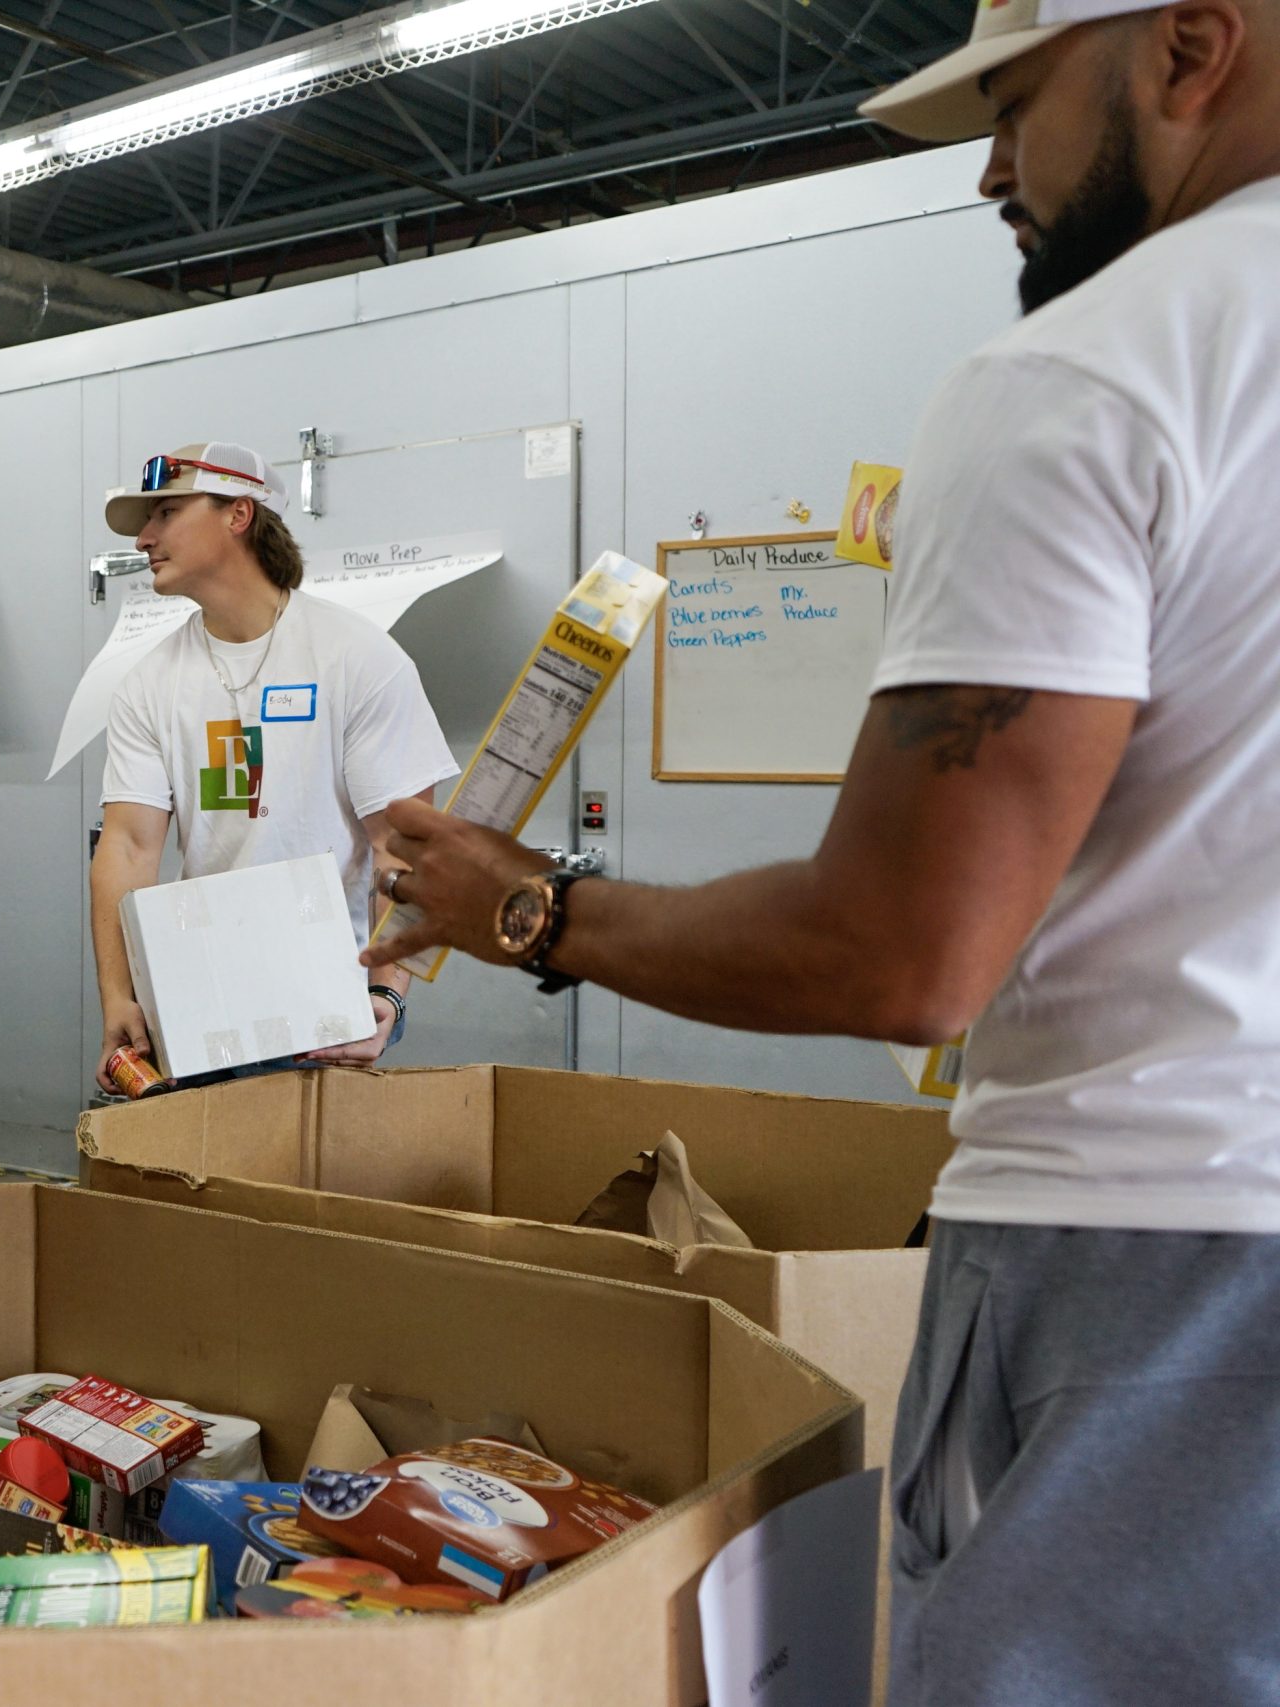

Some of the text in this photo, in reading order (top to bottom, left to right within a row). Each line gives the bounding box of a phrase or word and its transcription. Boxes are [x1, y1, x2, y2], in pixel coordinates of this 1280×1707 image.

[390, 544, 422, 562] Prep
[709, 546, 830, 570] Daily Produce
[669, 578, 734, 599] Carrots
[783, 603, 839, 621] Produce
[553, 620, 616, 664] Cheerios
[668, 628, 767, 649] Green Peppers
[216, 735, 260, 800] E
[440, 1470, 496, 1502] Bran
[447, 1466, 523, 1504] Flakes
